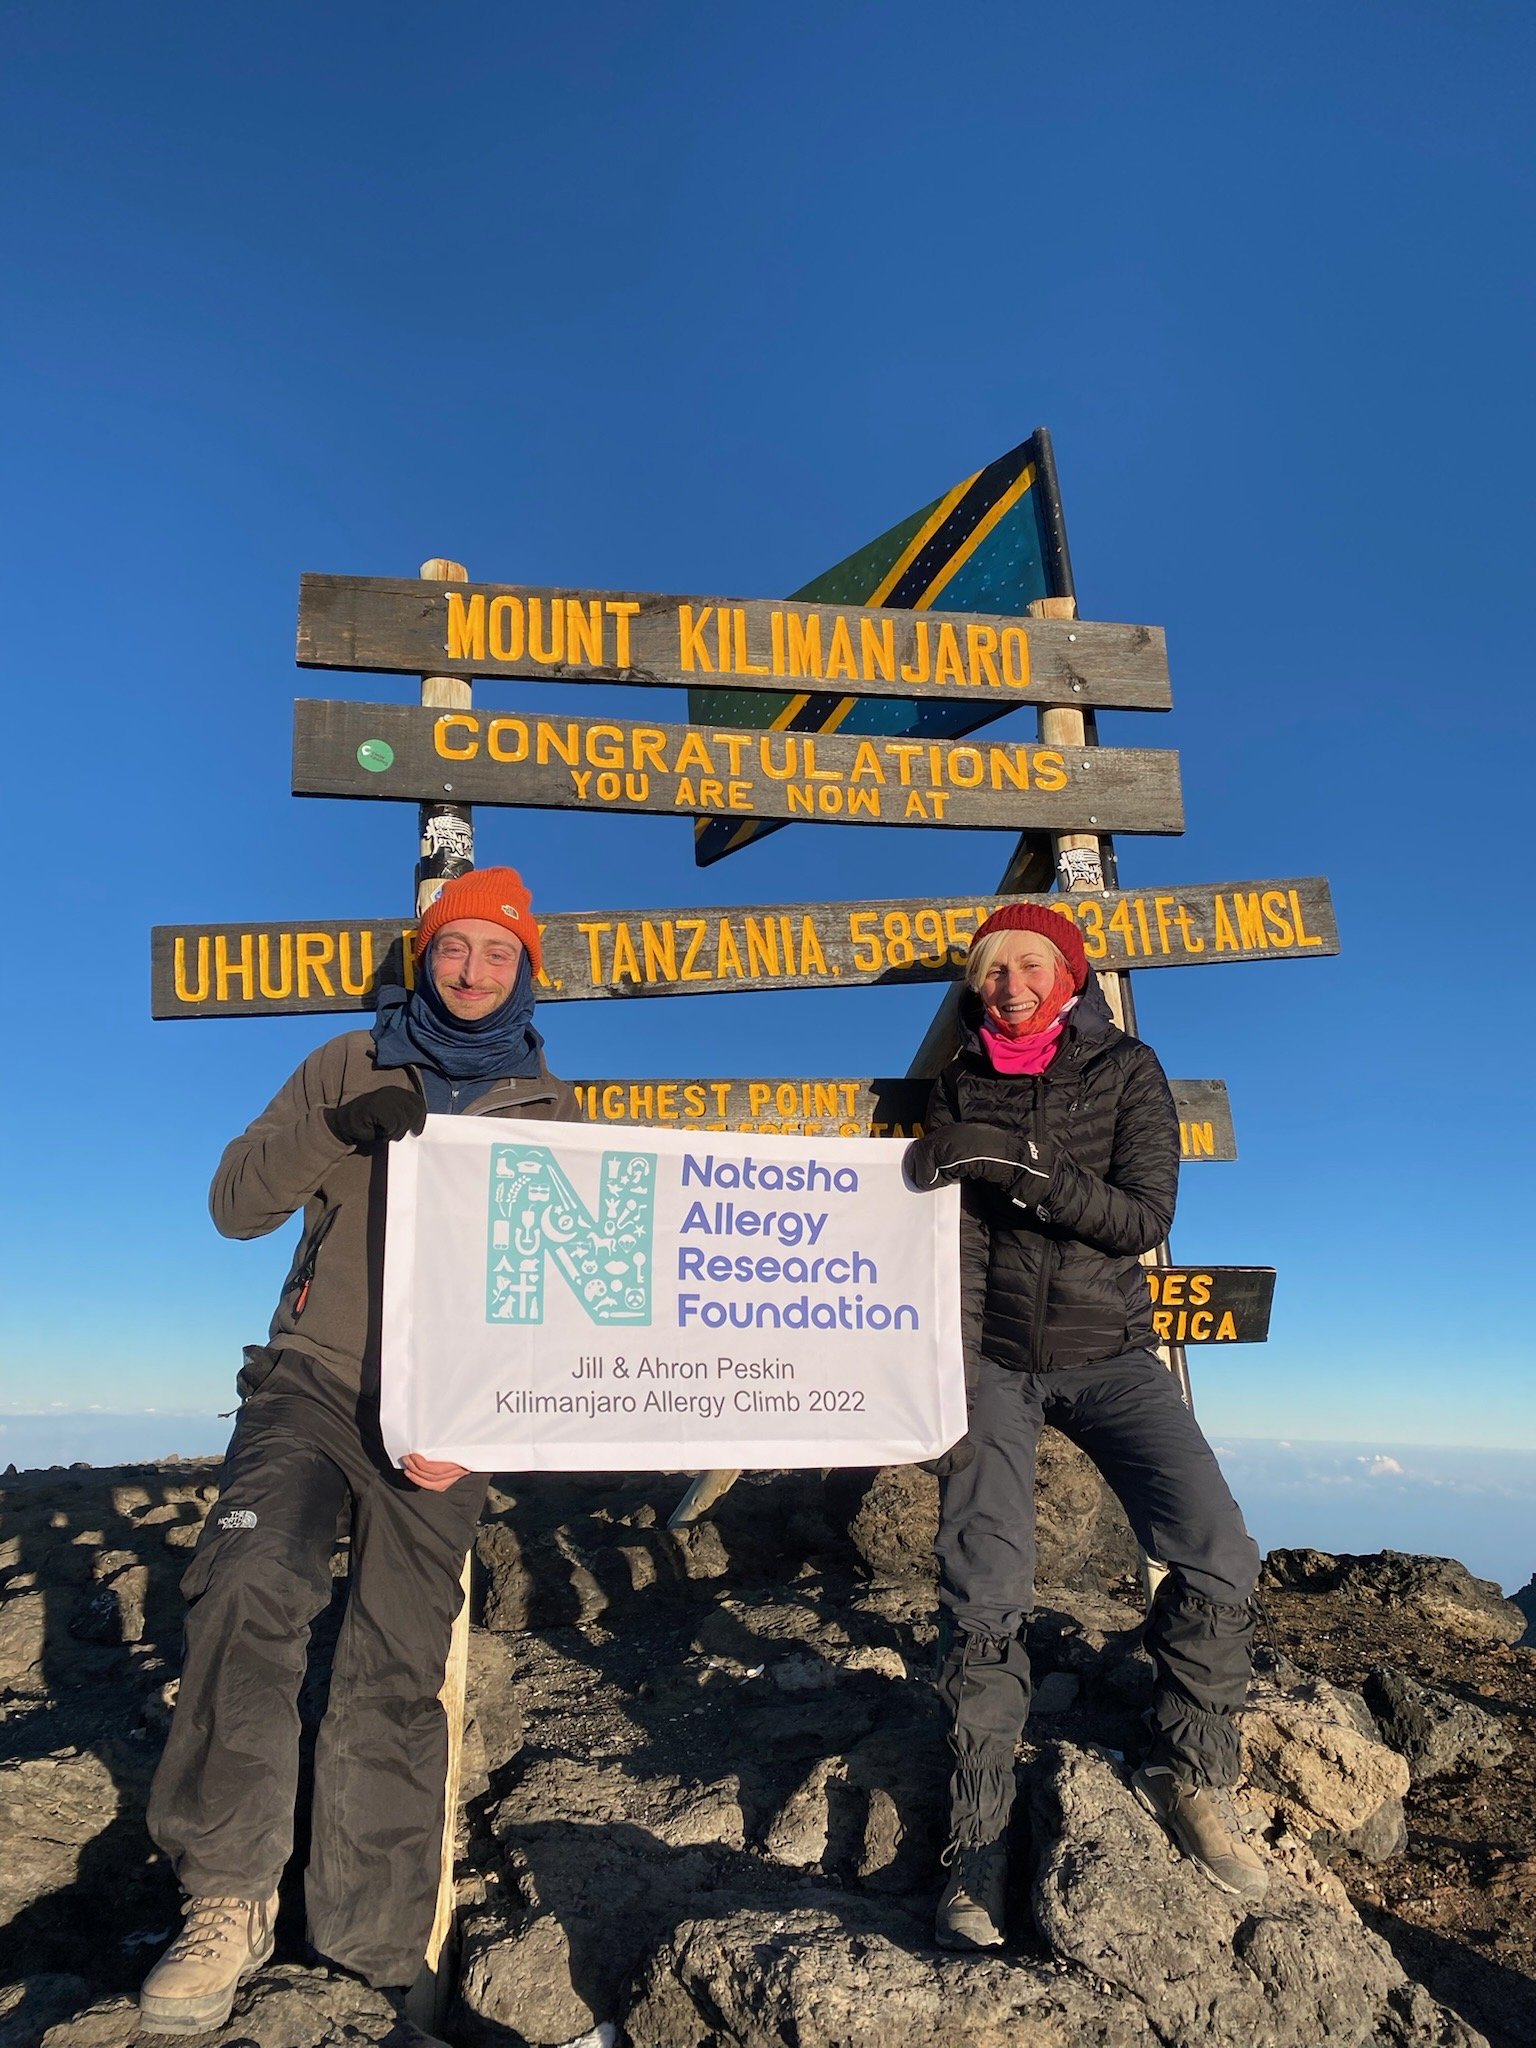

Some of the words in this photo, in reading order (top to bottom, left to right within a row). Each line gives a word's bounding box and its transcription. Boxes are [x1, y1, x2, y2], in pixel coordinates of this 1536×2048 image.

[446, 592, 640, 668] MOUNT
[678, 604, 1031, 687] KILIMANJARO
[433, 713, 1069, 791] CONGRATULATIONS
[571, 769, 650, 803] YOU
[674, 776, 754, 811] ARE
[786, 784, 881, 817] NOW
[905, 792, 951, 820] AT
[173, 929, 374, 1003] UHURU
[577, 914, 842, 985] TANZANIA,
[1048, 896, 1205, 959] 341Ft
[1215, 890, 1323, 951] AMSL
[574, 1082, 732, 1120] IGHEST
[749, 1083, 861, 1117] POINT
[681, 1153, 859, 1193] Natasha
[679, 1201, 829, 1247] Allergy
[678, 1247, 878, 1284] Research
[678, 1293, 919, 1330] Foundation
[1153, 1311, 1238, 1341] RICA
[571, 1355, 604, 1379] Jill
[613, 1356, 631, 1379] &
[636, 1356, 708, 1380] Ahron
[717, 1357, 796, 1380] Peskin
[495, 1390, 636, 1419] Kilimanjaro
[643, 1390, 727, 1419] Allergy
[733, 1390, 801, 1414] Climb
[808, 1390, 866, 1413] 2022
